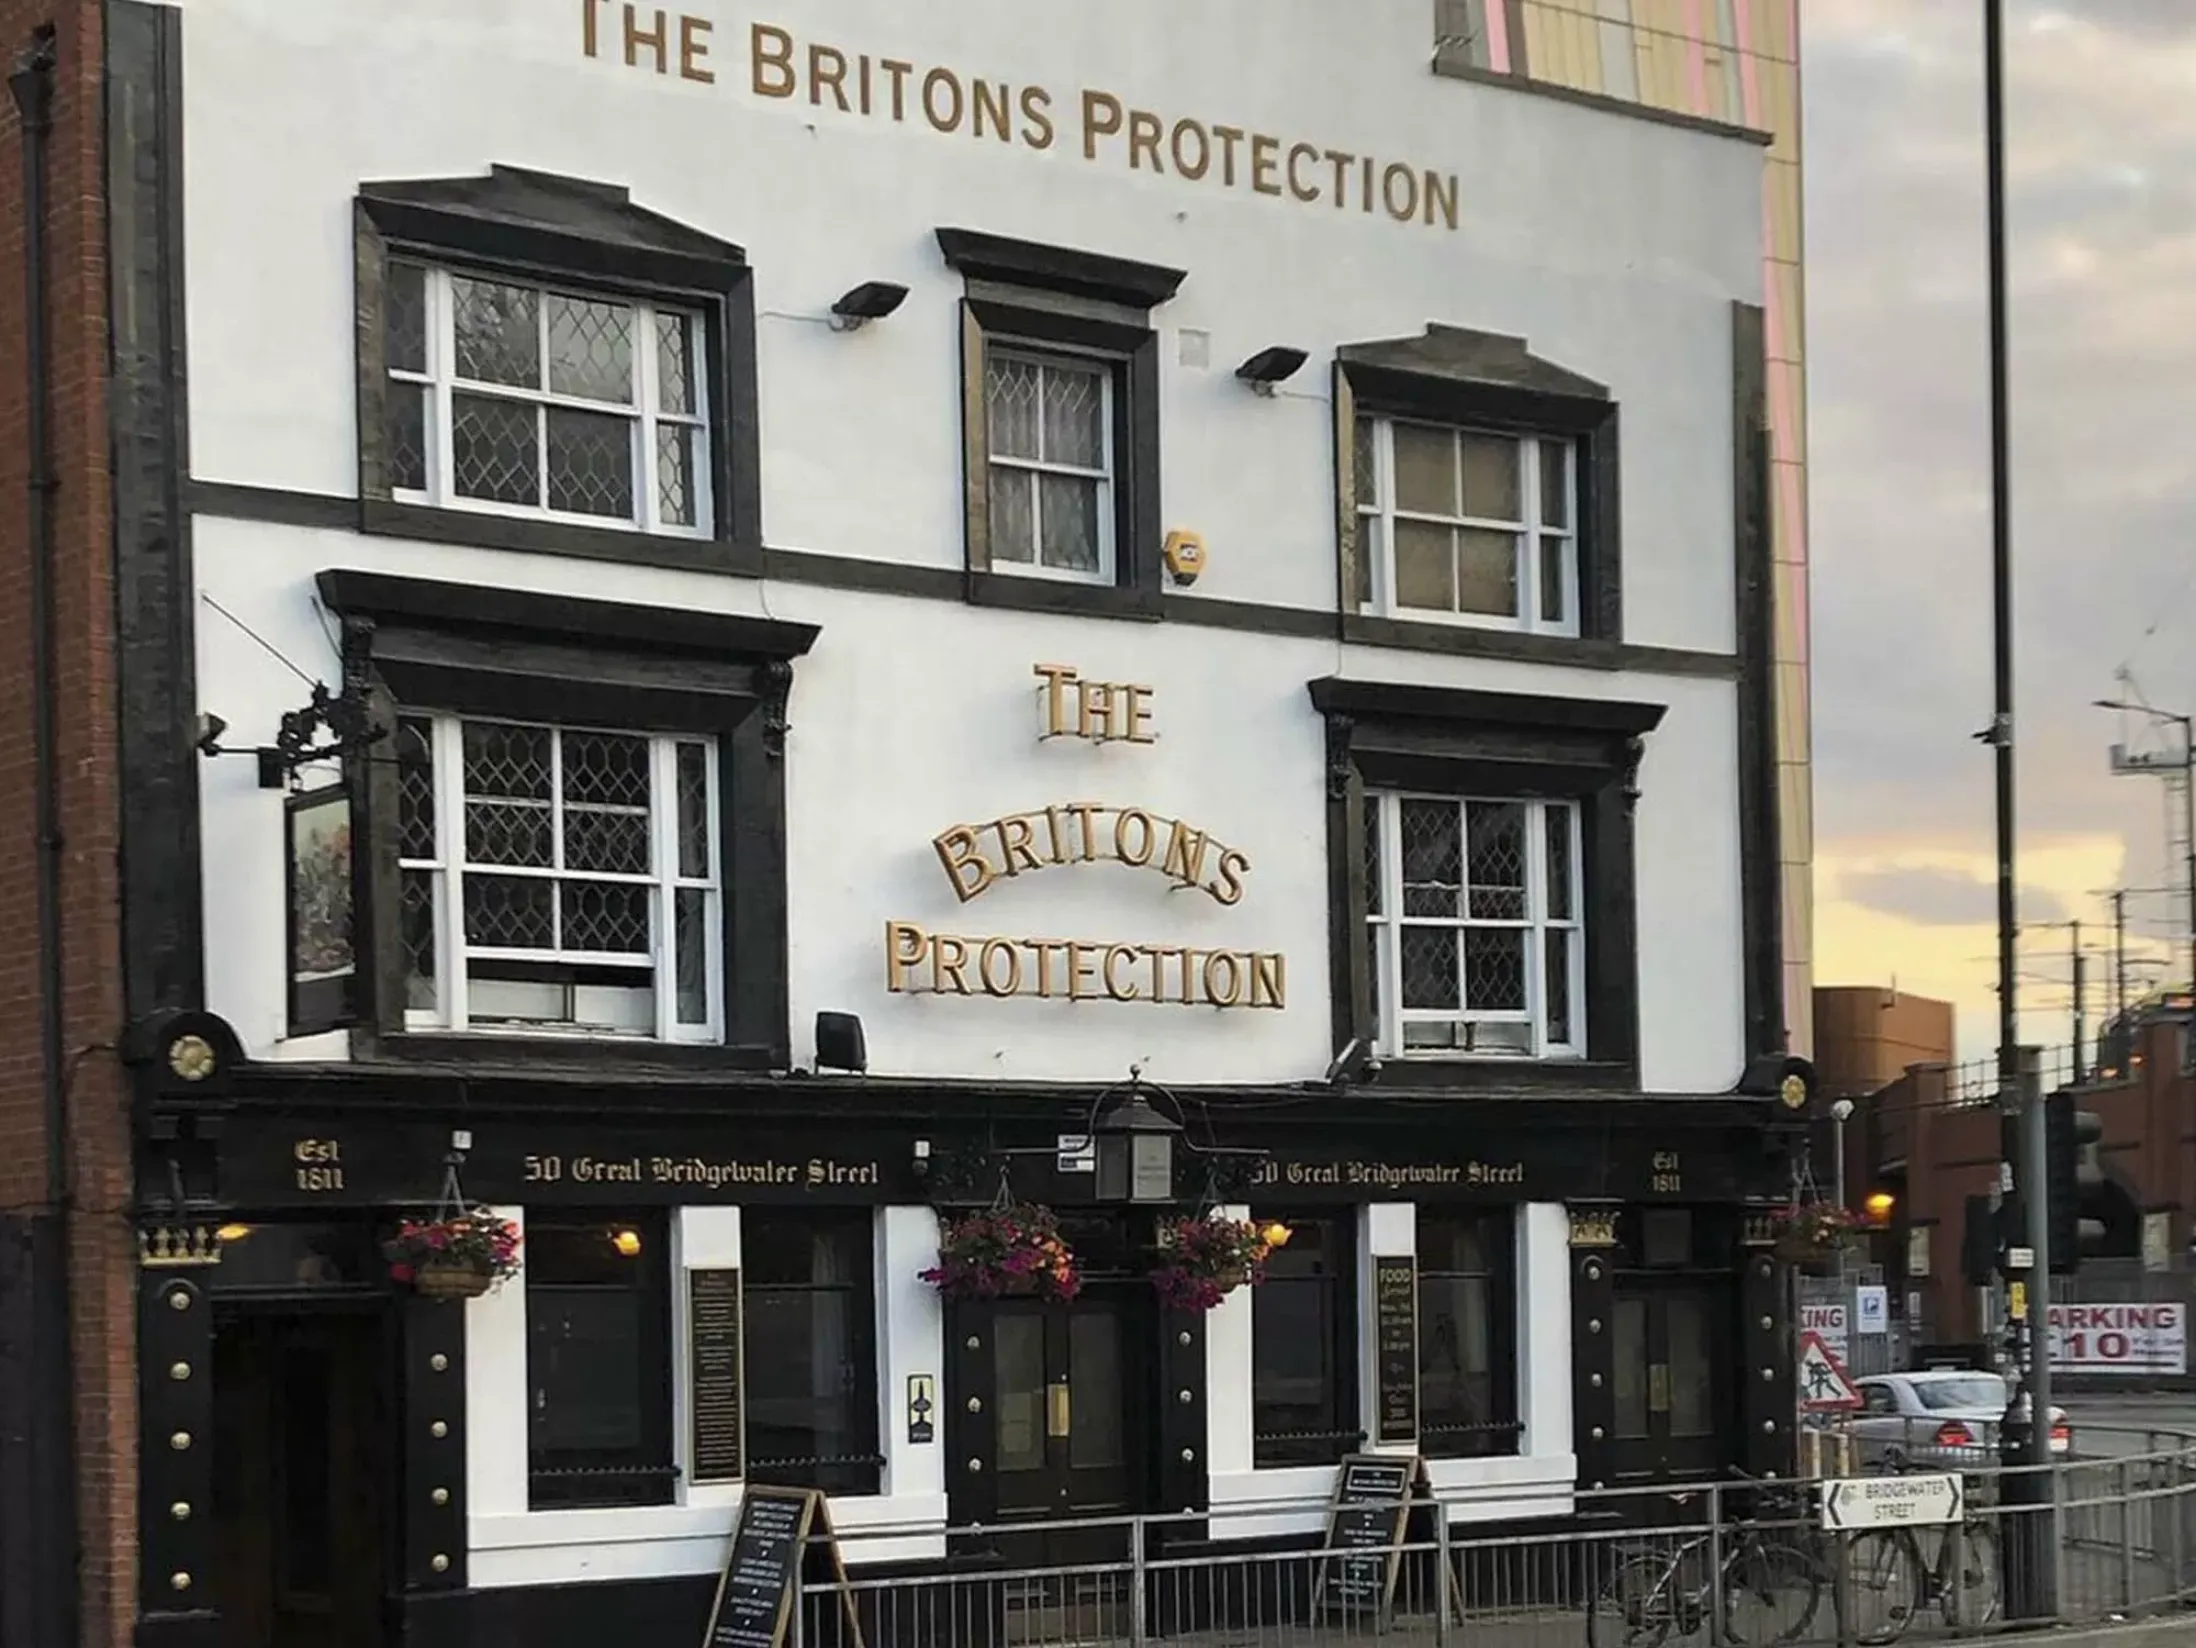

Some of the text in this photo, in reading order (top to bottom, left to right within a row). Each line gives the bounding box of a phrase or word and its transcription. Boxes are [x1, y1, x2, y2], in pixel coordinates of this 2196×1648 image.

[583, 0, 1459, 231] THE BRITONS PROTECTION
[1034, 663, 1154, 744] THE
[932, 803, 1250, 905] BRITONS
[886, 920, 1285, 1009] PROTECTION
[294, 1139, 339, 1161] Est
[296, 1167, 343, 1190] 1811
[524, 1155, 878, 1192] 50 Great Bridgewater Street
[1286, 1161, 1341, 1184] Great
[1347, 1160, 1461, 1190] Bridgewater
[1467, 1160, 1524, 1185] Street
[2047, 1307, 2176, 1329] ARKING
[2048, 1331, 2131, 1358] 10
[1865, 1480, 1945, 1500] BRIDGEWATER
[1874, 1502, 1916, 1520] STREET
